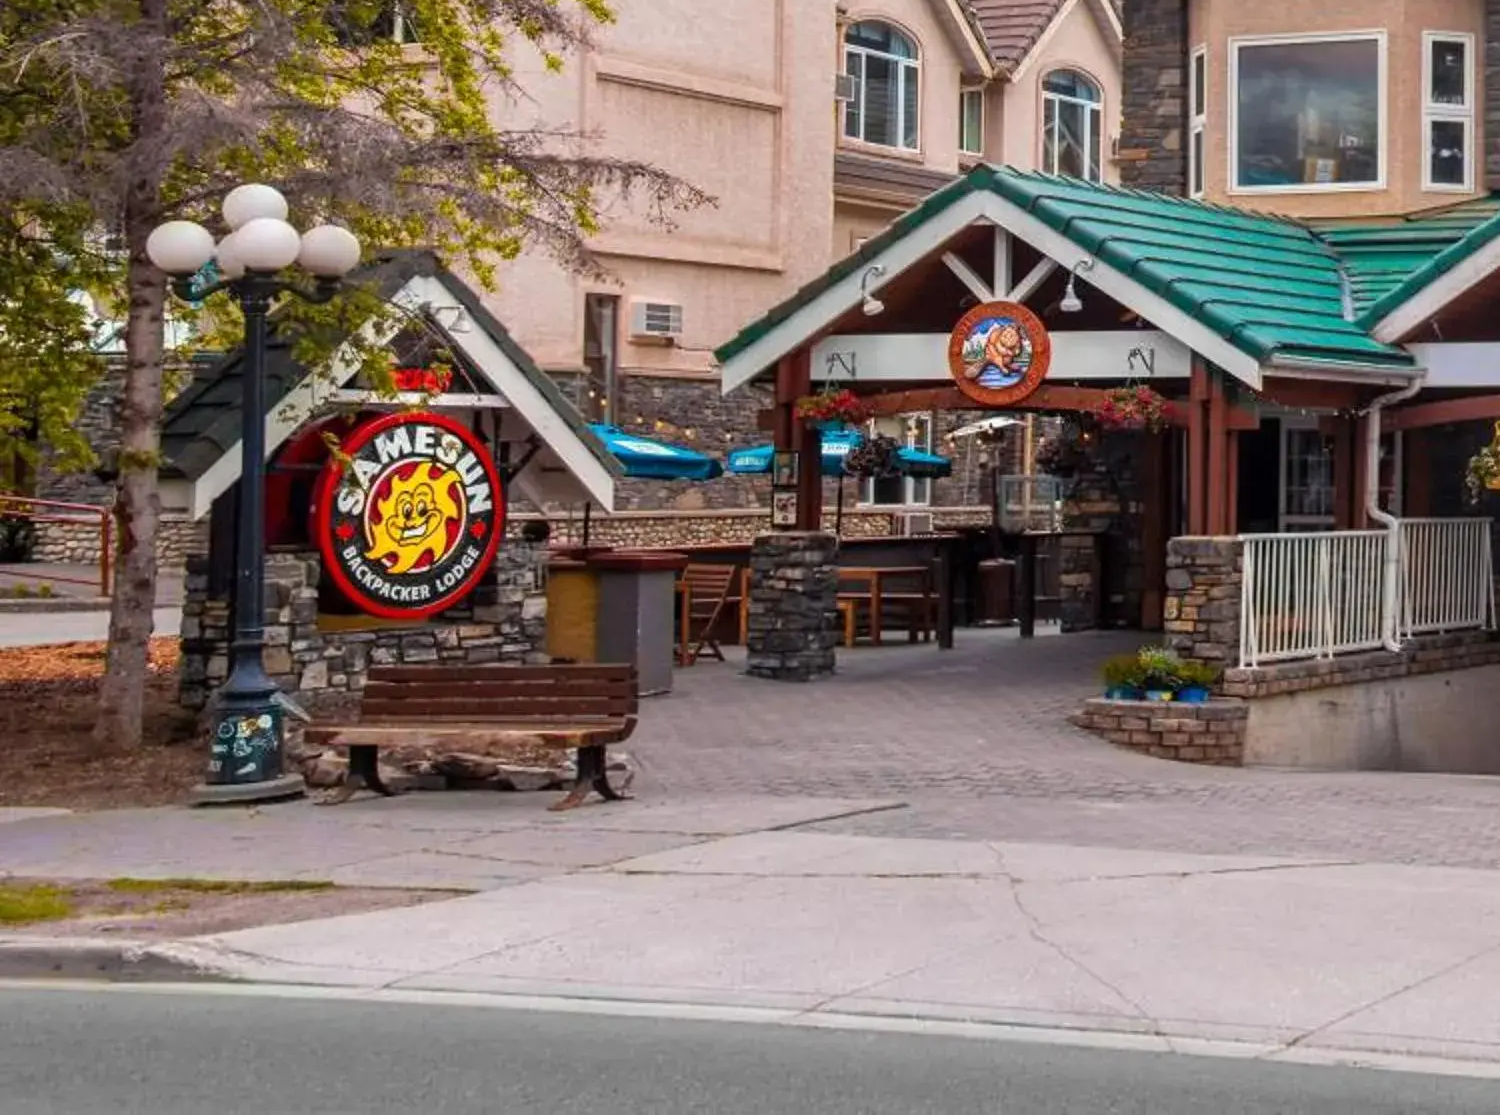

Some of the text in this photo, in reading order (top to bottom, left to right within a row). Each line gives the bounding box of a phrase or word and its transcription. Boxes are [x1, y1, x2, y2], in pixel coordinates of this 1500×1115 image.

[337, 426, 493, 516] SAMESUN
[342, 545, 480, 601] BACKPACKER LODGE
